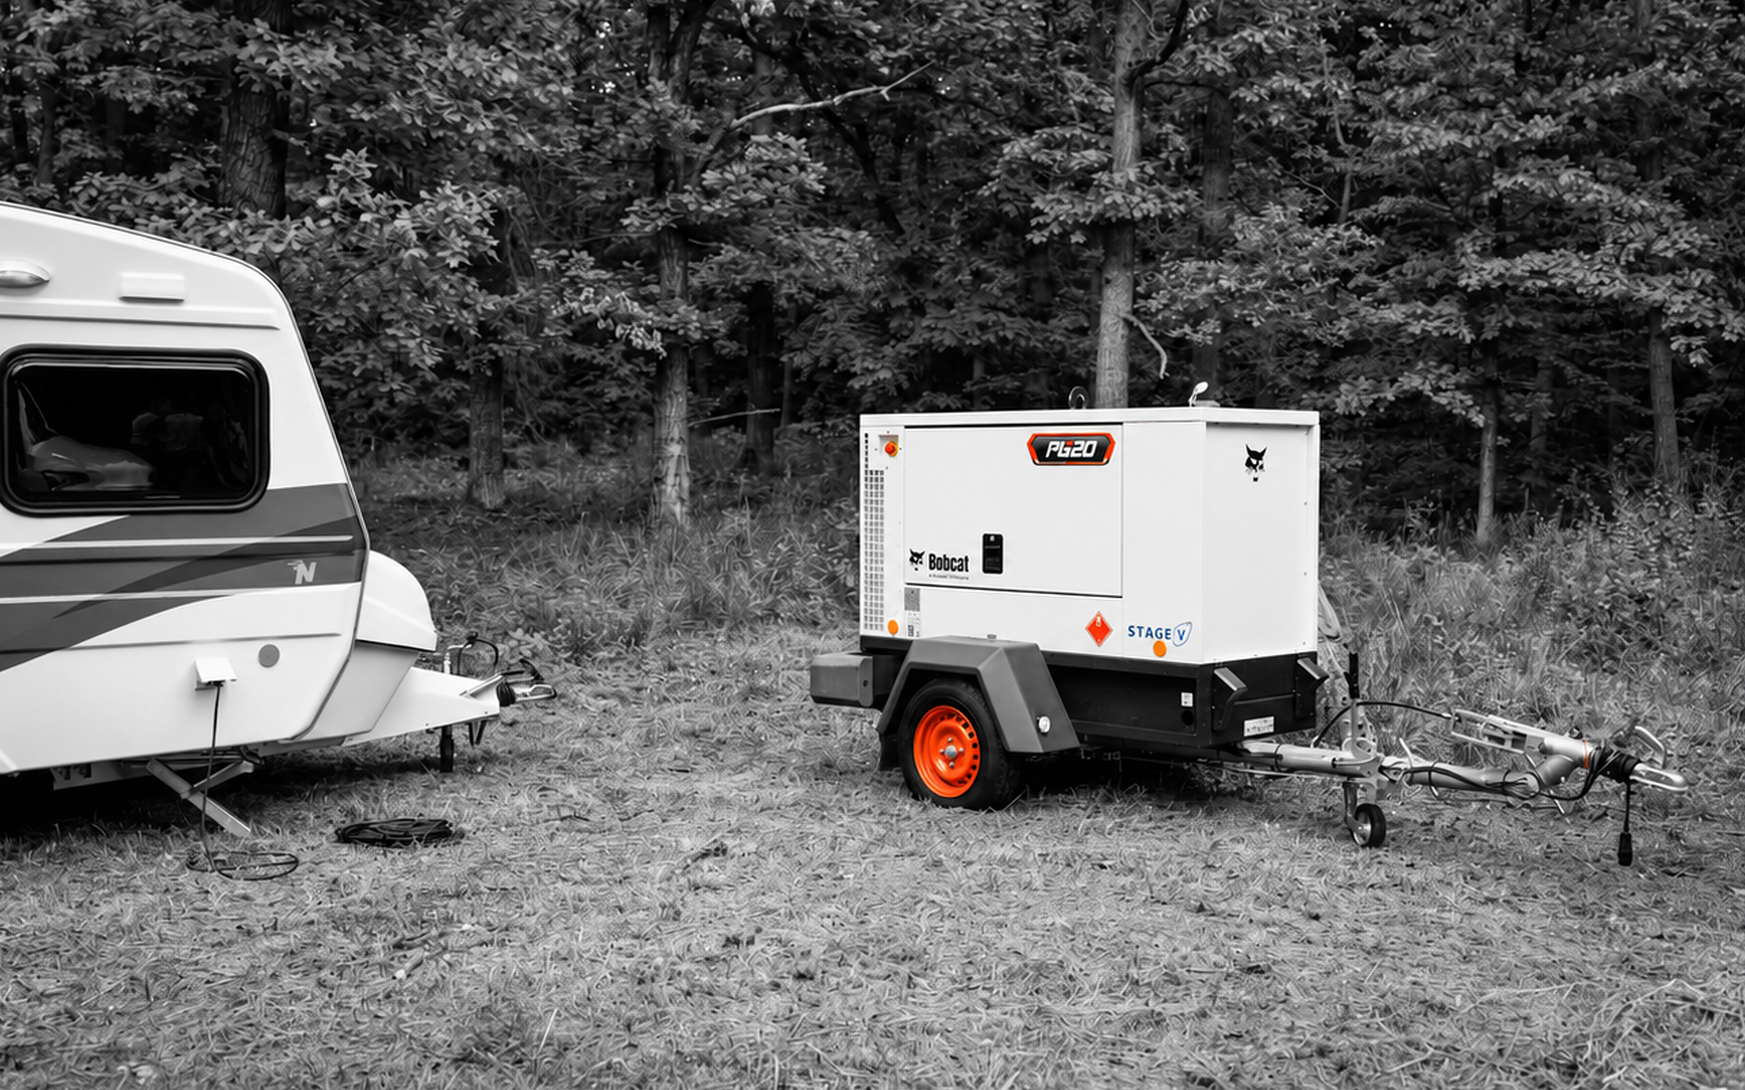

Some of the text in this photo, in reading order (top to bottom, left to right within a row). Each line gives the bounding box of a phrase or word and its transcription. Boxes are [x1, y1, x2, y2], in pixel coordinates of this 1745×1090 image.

[1045, 440, 1098, 458] PG20
[928, 553, 969, 573] Bobcat
[1127, 625, 1186, 641] STAGE V
